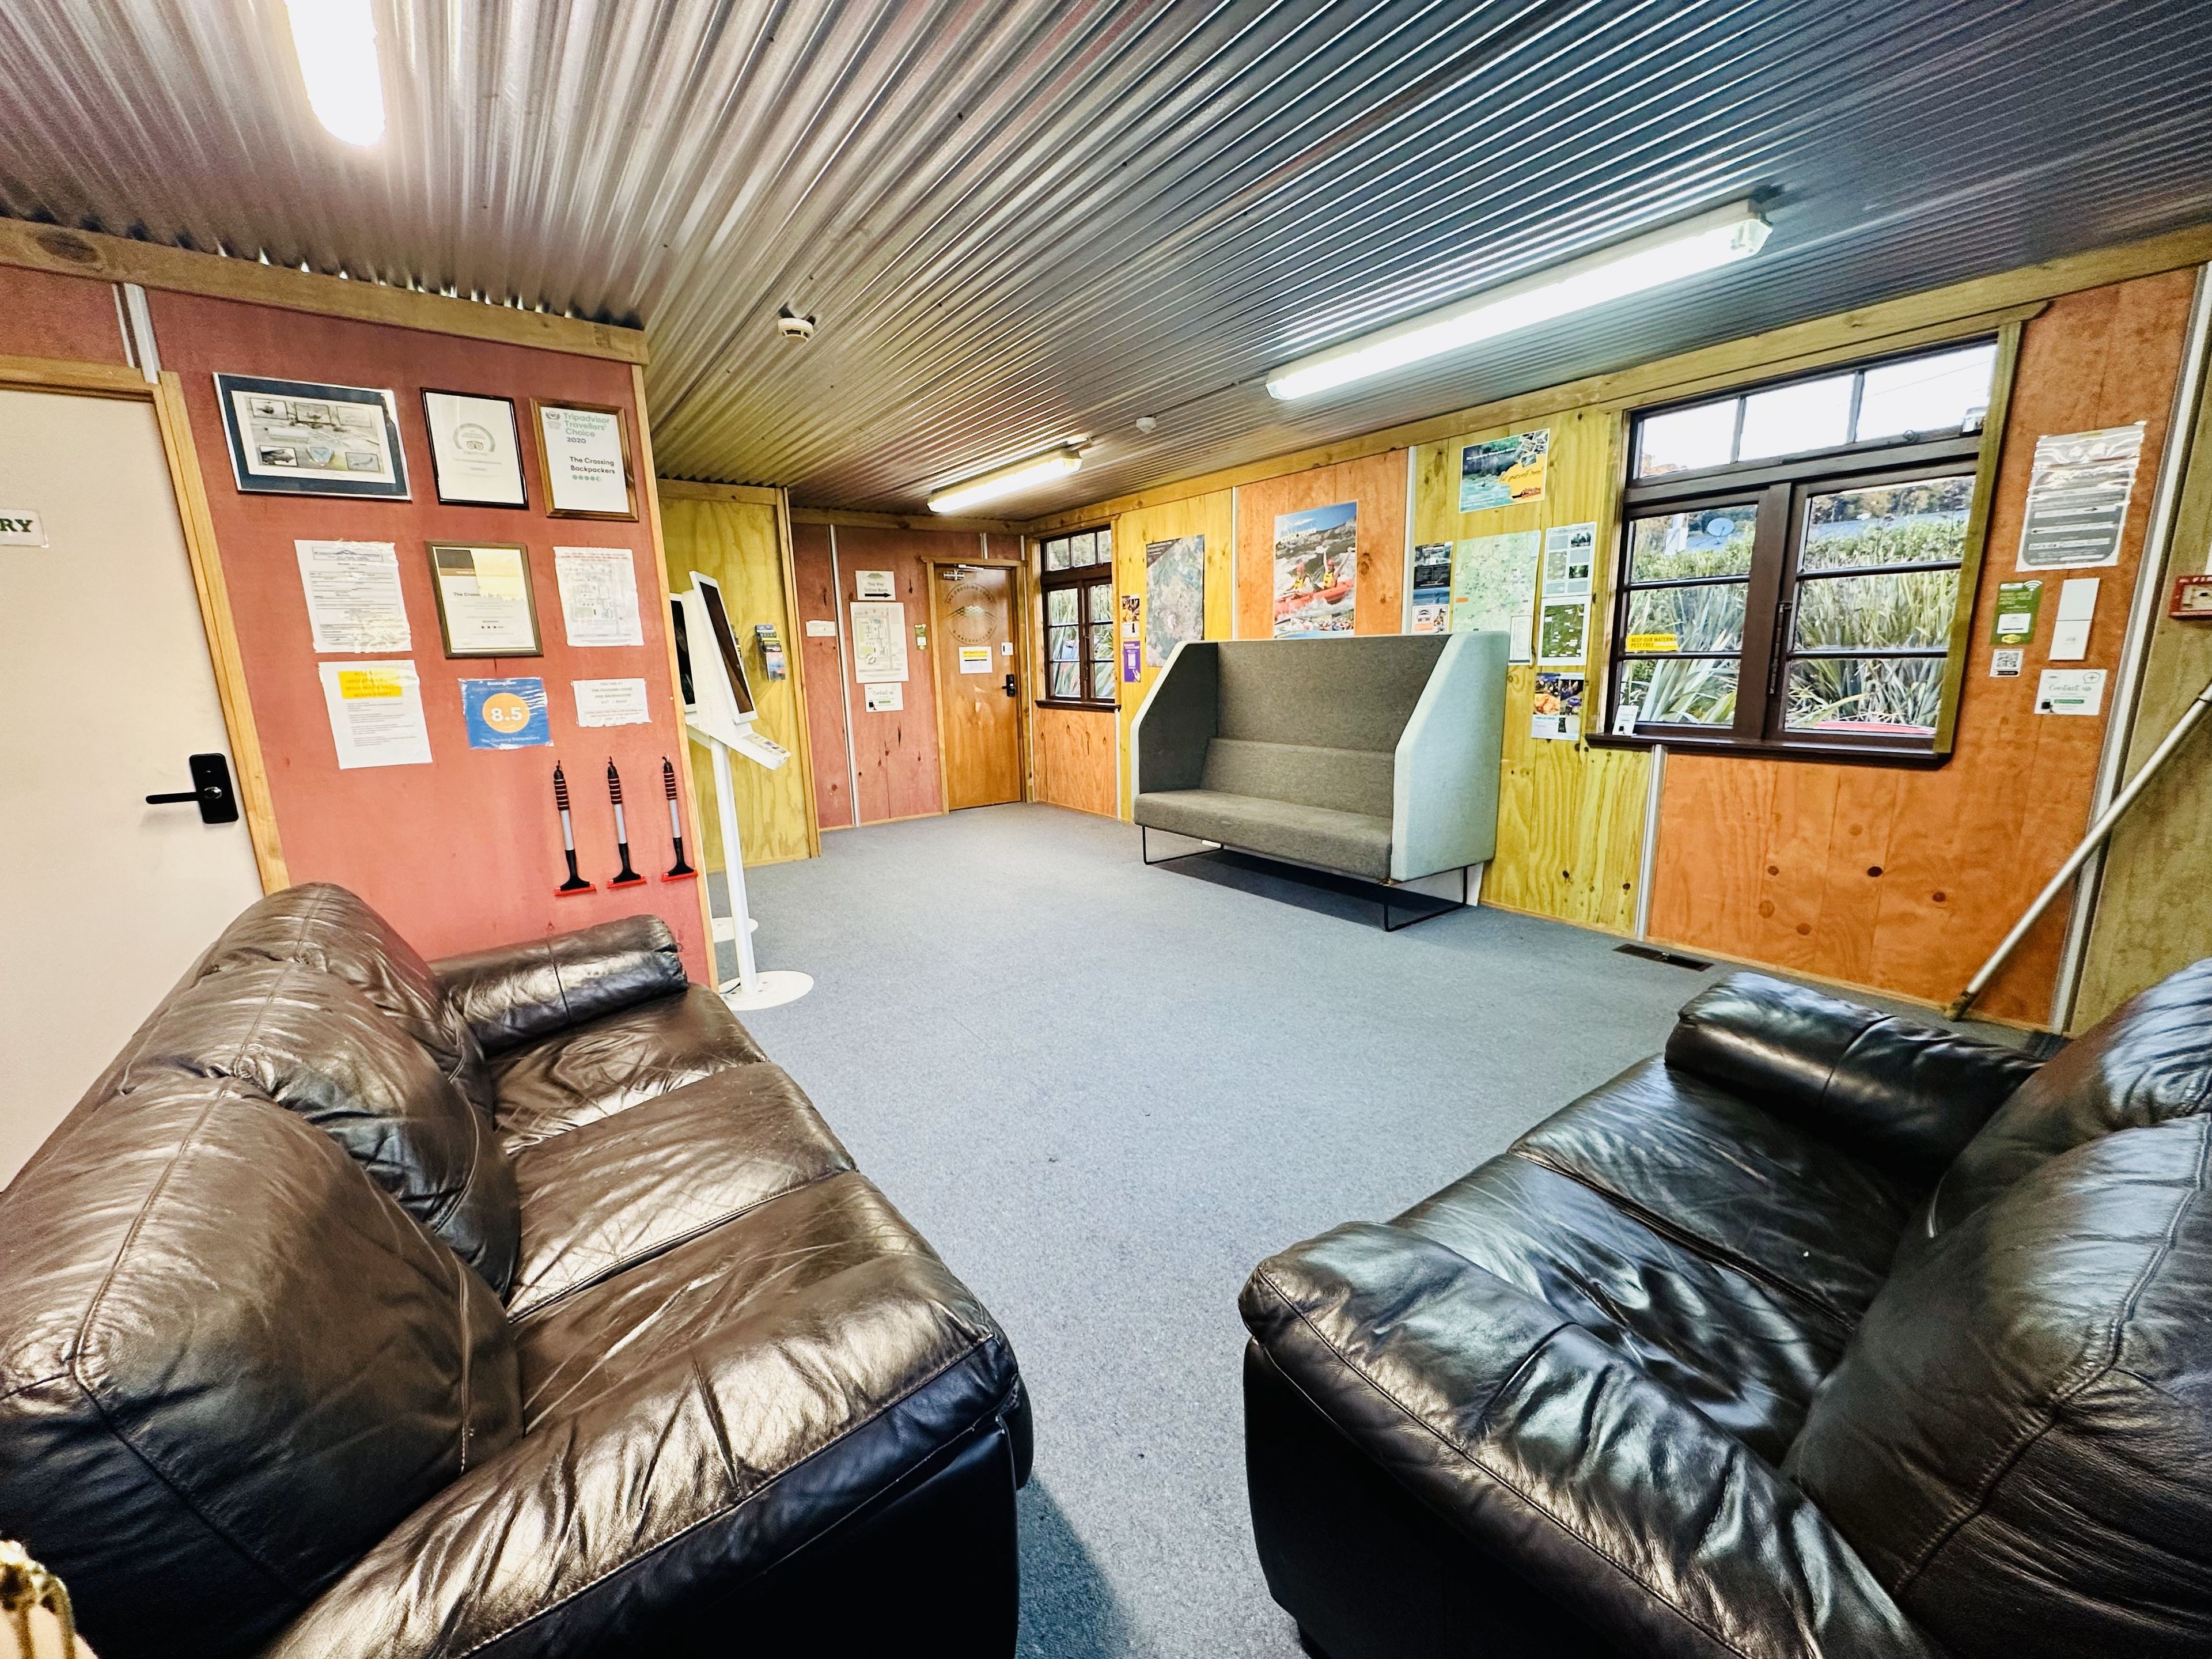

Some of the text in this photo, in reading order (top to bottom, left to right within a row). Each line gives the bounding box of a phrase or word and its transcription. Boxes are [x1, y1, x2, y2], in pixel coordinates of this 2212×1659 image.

[563, 412, 609, 424] Tripadvisor
[566, 428, 595, 437] Choice
[584, 457, 614, 467] Crossing
[570, 465, 615, 474] Backpackers
[490, 707, 523, 722] 8.5
